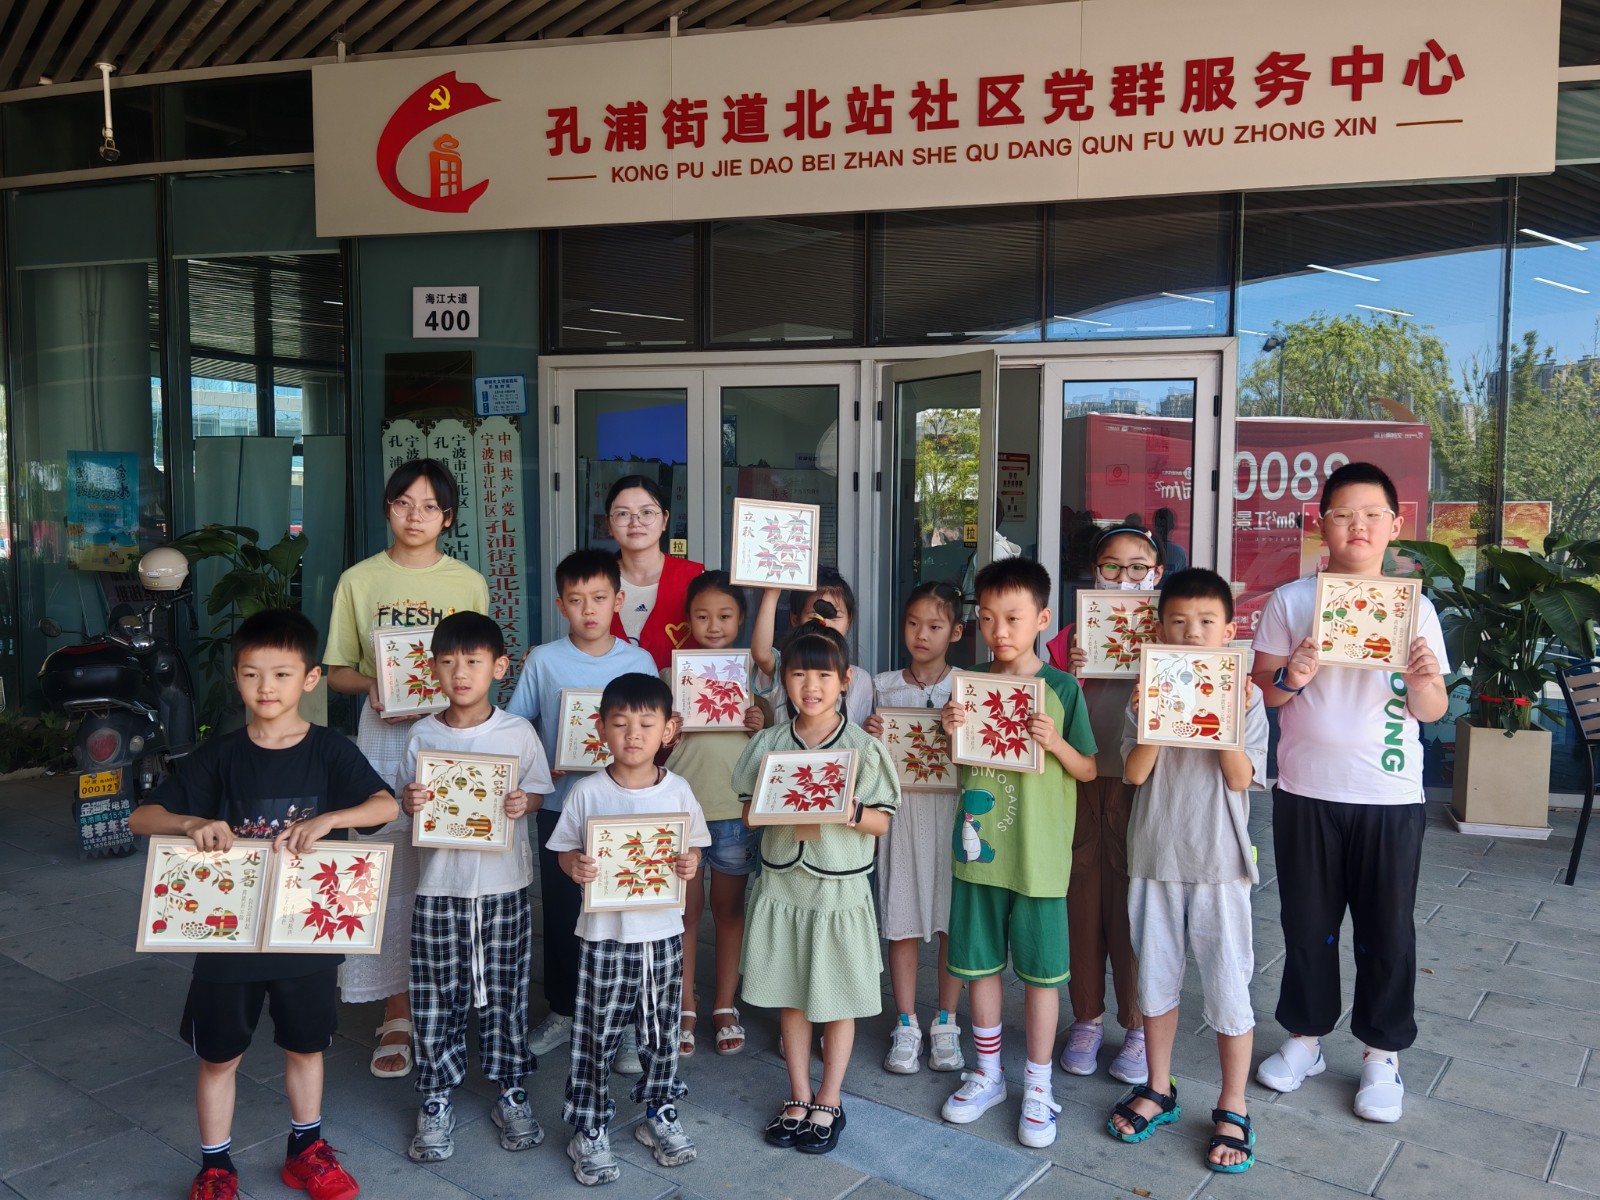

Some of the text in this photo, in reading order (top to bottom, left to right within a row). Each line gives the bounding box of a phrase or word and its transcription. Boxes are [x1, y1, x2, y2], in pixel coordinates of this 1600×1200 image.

[546, 38, 1466, 157] 孔浦街道北站社区党群服务中心
[611, 115, 1377, 184] KONG PU JIE DAO BEI ZHAN SHE QU DANG QUN FU WU ZHONG XIN
[425, 293, 468, 305] 海江大道
[425, 310, 470, 331] 400
[481, 432, 498, 518] 宁波市江北区
[498, 431, 515, 517] 中国共产党
[742, 512, 756, 538] 立秋
[966, 527, 975, 540] 拉
[673, 541, 684, 552] 拉
[378, 606, 443, 627] FRESH
[1087, 601, 1101, 628] 立秋
[1391, 586, 1410, 620] 处暑
[386, 640, 401, 668] 立秋
[681, 661, 694, 687] 立秋
[1218, 657, 1235, 692] 处暑
[964, 683, 978, 713] 立秋
[570, 701, 584, 726] 立秋
[1381, 671, 1408, 773] OUNG
[887, 719, 901, 744] 立秋
[491, 764, 507, 797] 处暑
[768, 764, 785, 785] 立秋
[597, 829, 613, 859] 立秋
[239, 849, 261, 888] 处暑
[285, 854, 305, 890] 立秋
